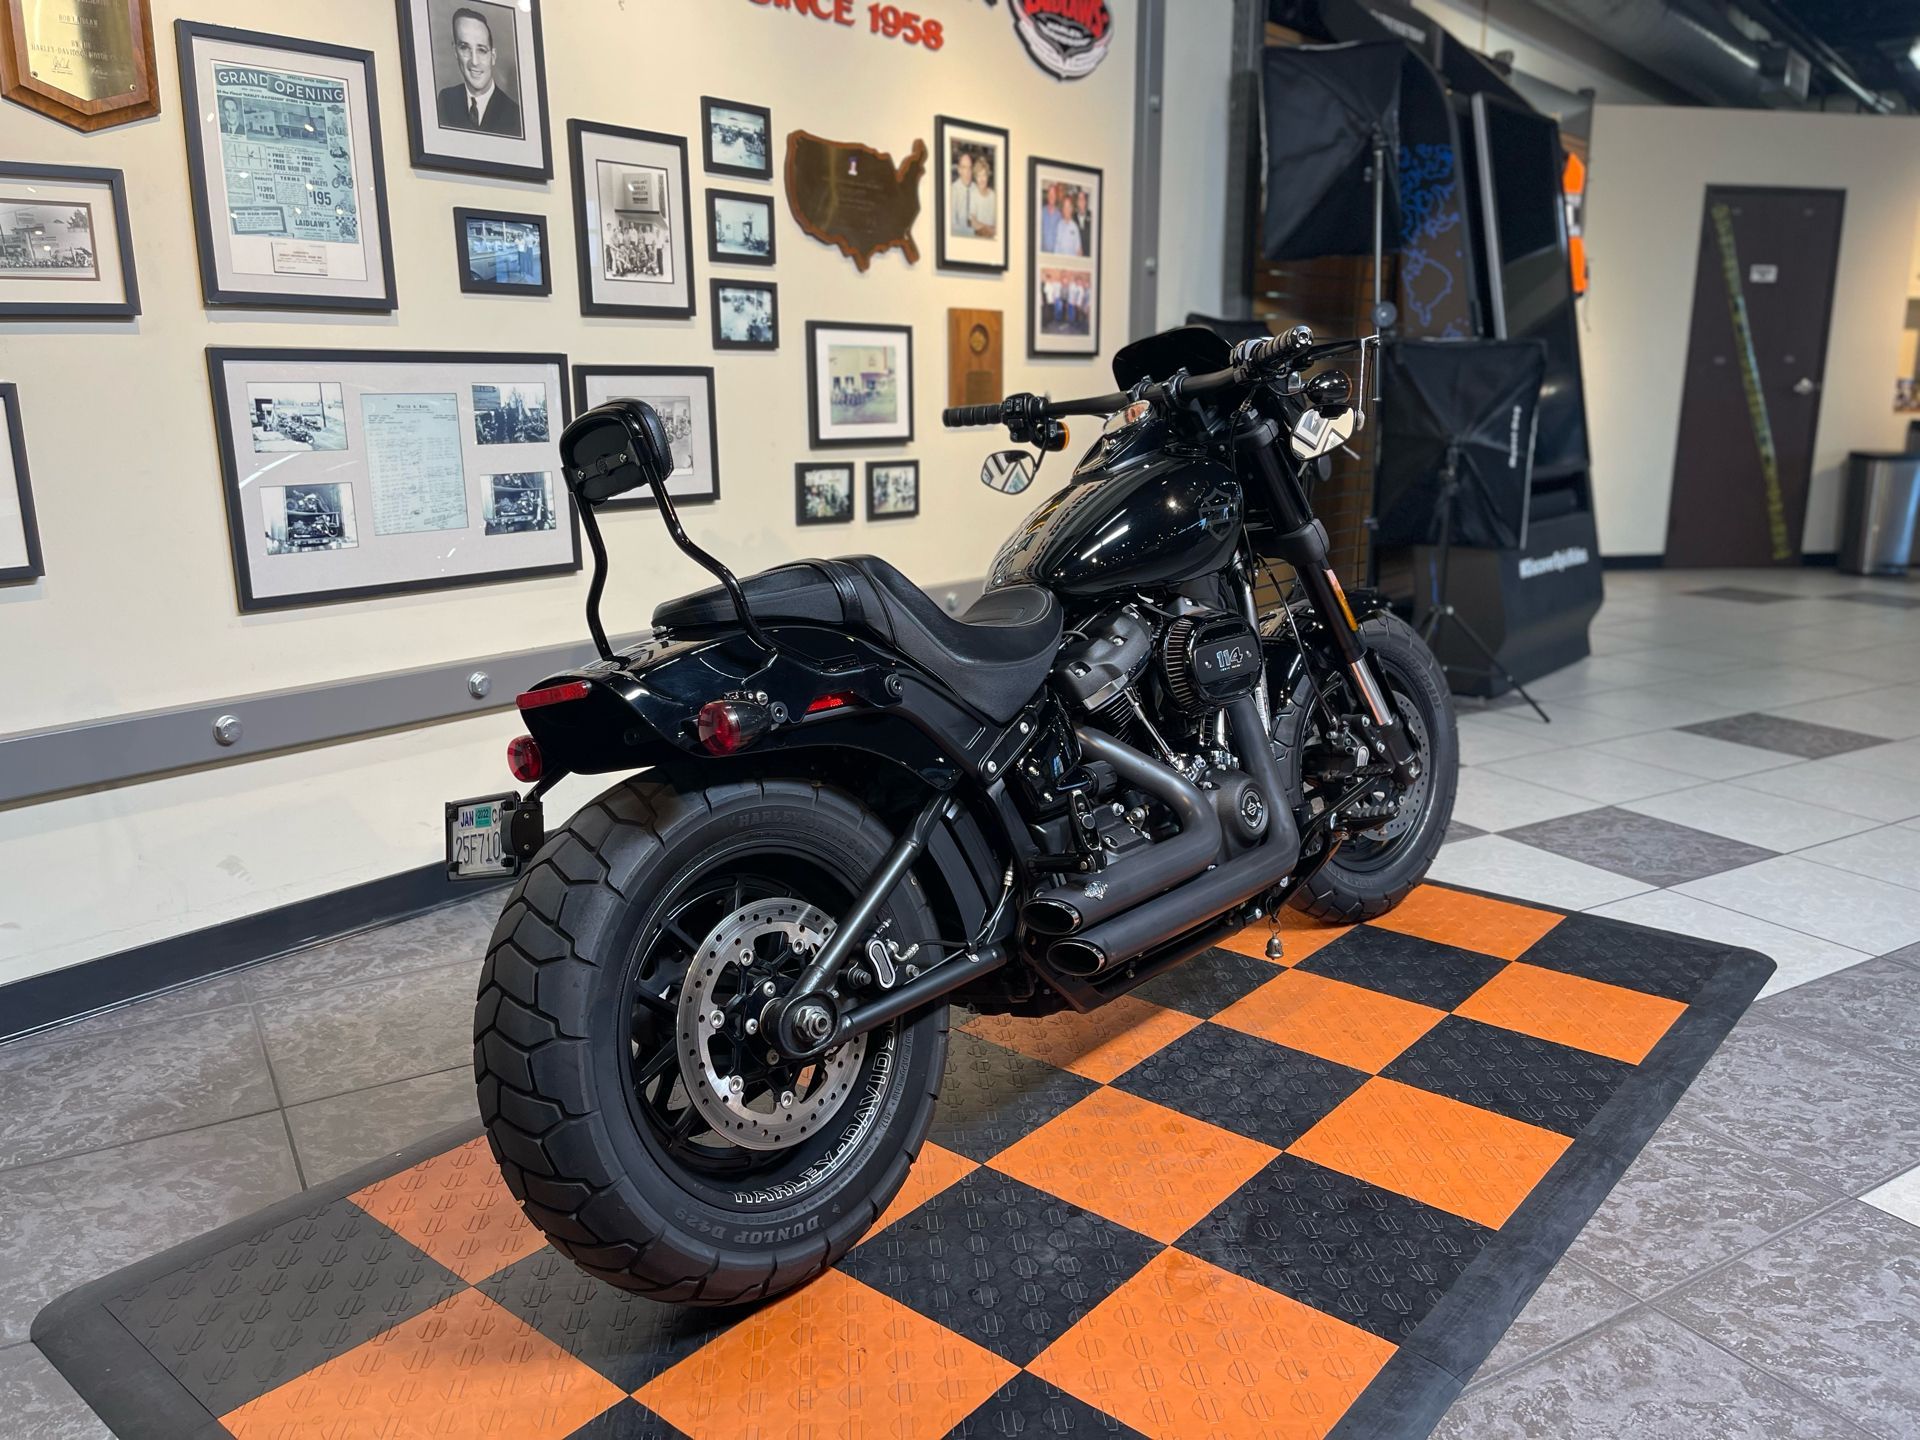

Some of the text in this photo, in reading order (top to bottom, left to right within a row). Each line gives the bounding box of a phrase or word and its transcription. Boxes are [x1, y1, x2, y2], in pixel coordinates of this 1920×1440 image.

[748, 0, 944, 50] NCE 1958
[218, 71, 344, 101] GRAND OPENING
[309, 190, 332, 206] $195
[1216, 646, 1244, 668] 114
[460, 810, 474, 828] JAN
[673, 1208, 820, 1245] DUNLOP D429
